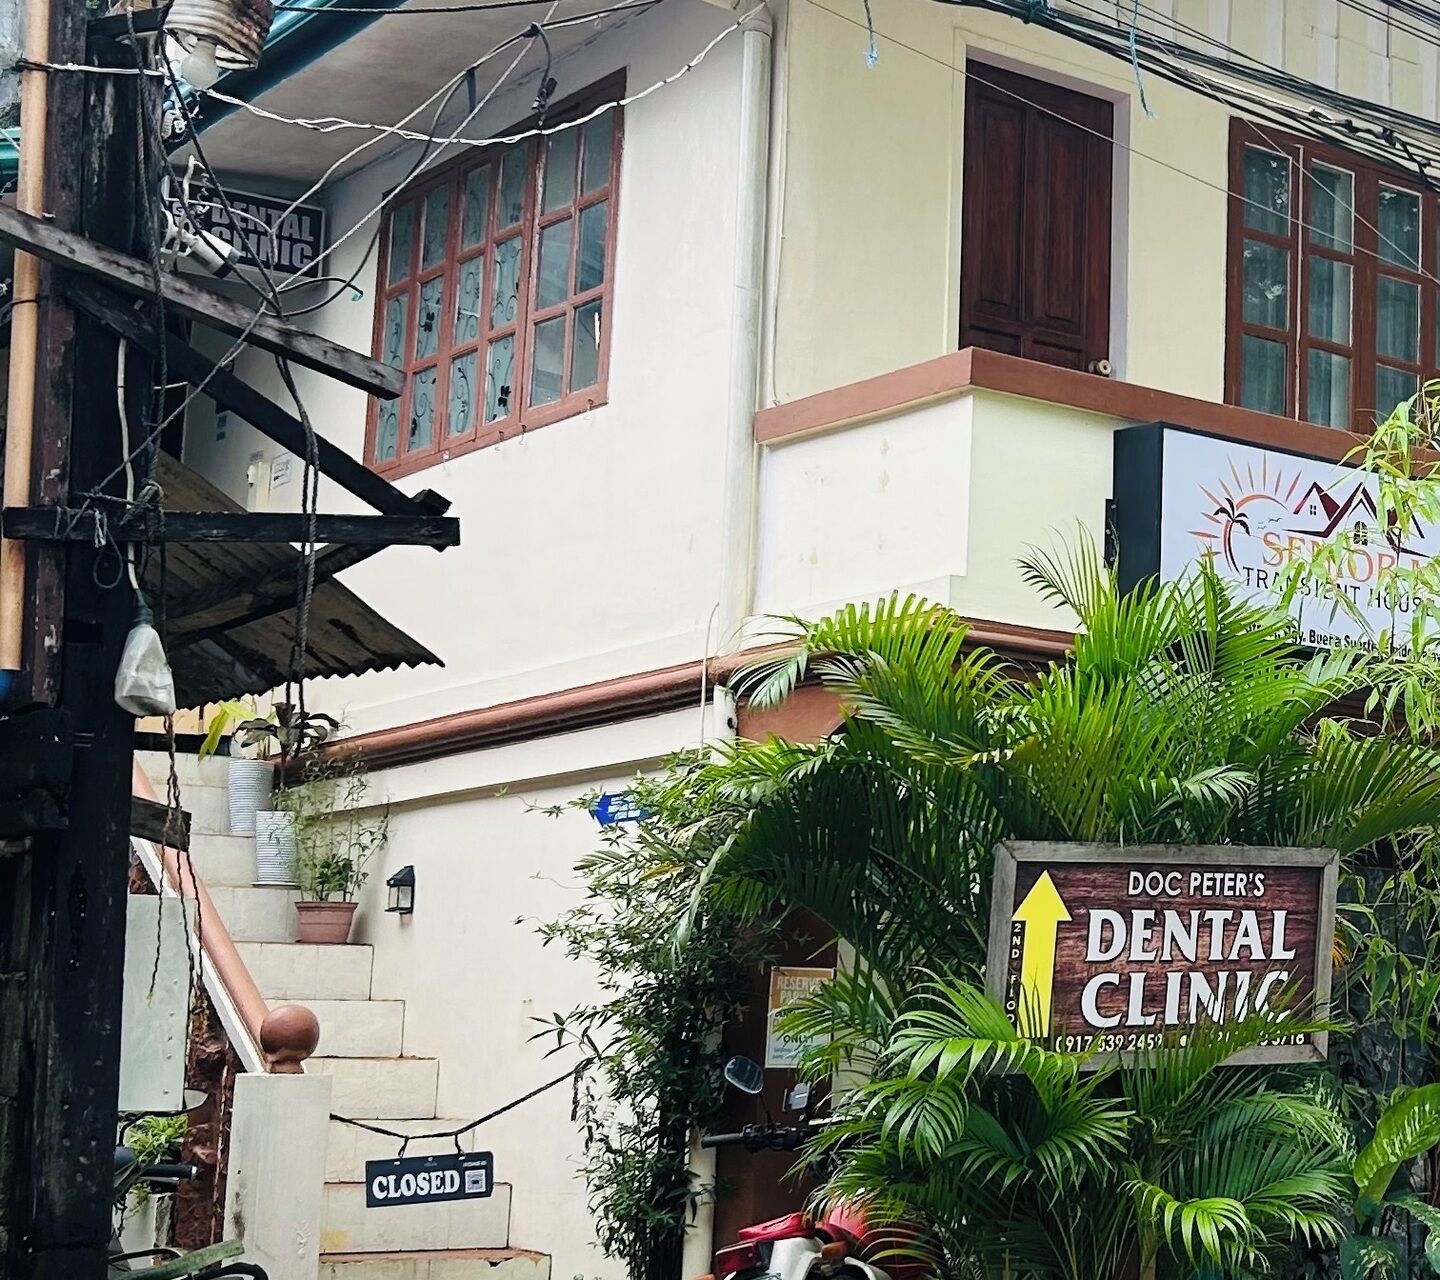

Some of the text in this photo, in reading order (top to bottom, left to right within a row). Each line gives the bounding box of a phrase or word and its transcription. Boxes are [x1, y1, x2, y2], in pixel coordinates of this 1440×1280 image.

[211, 196, 314, 242] DENTAL
[210, 226, 313, 269] CLINIC
[1128, 871, 1265, 897] DOC PETER'S
[1011, 923, 1022, 959] 2ND
[1085, 909, 1296, 962] DENTAL
[1081, 971, 1292, 1028] CLINIC
[372, 1169, 460, 1199] CLOSED
